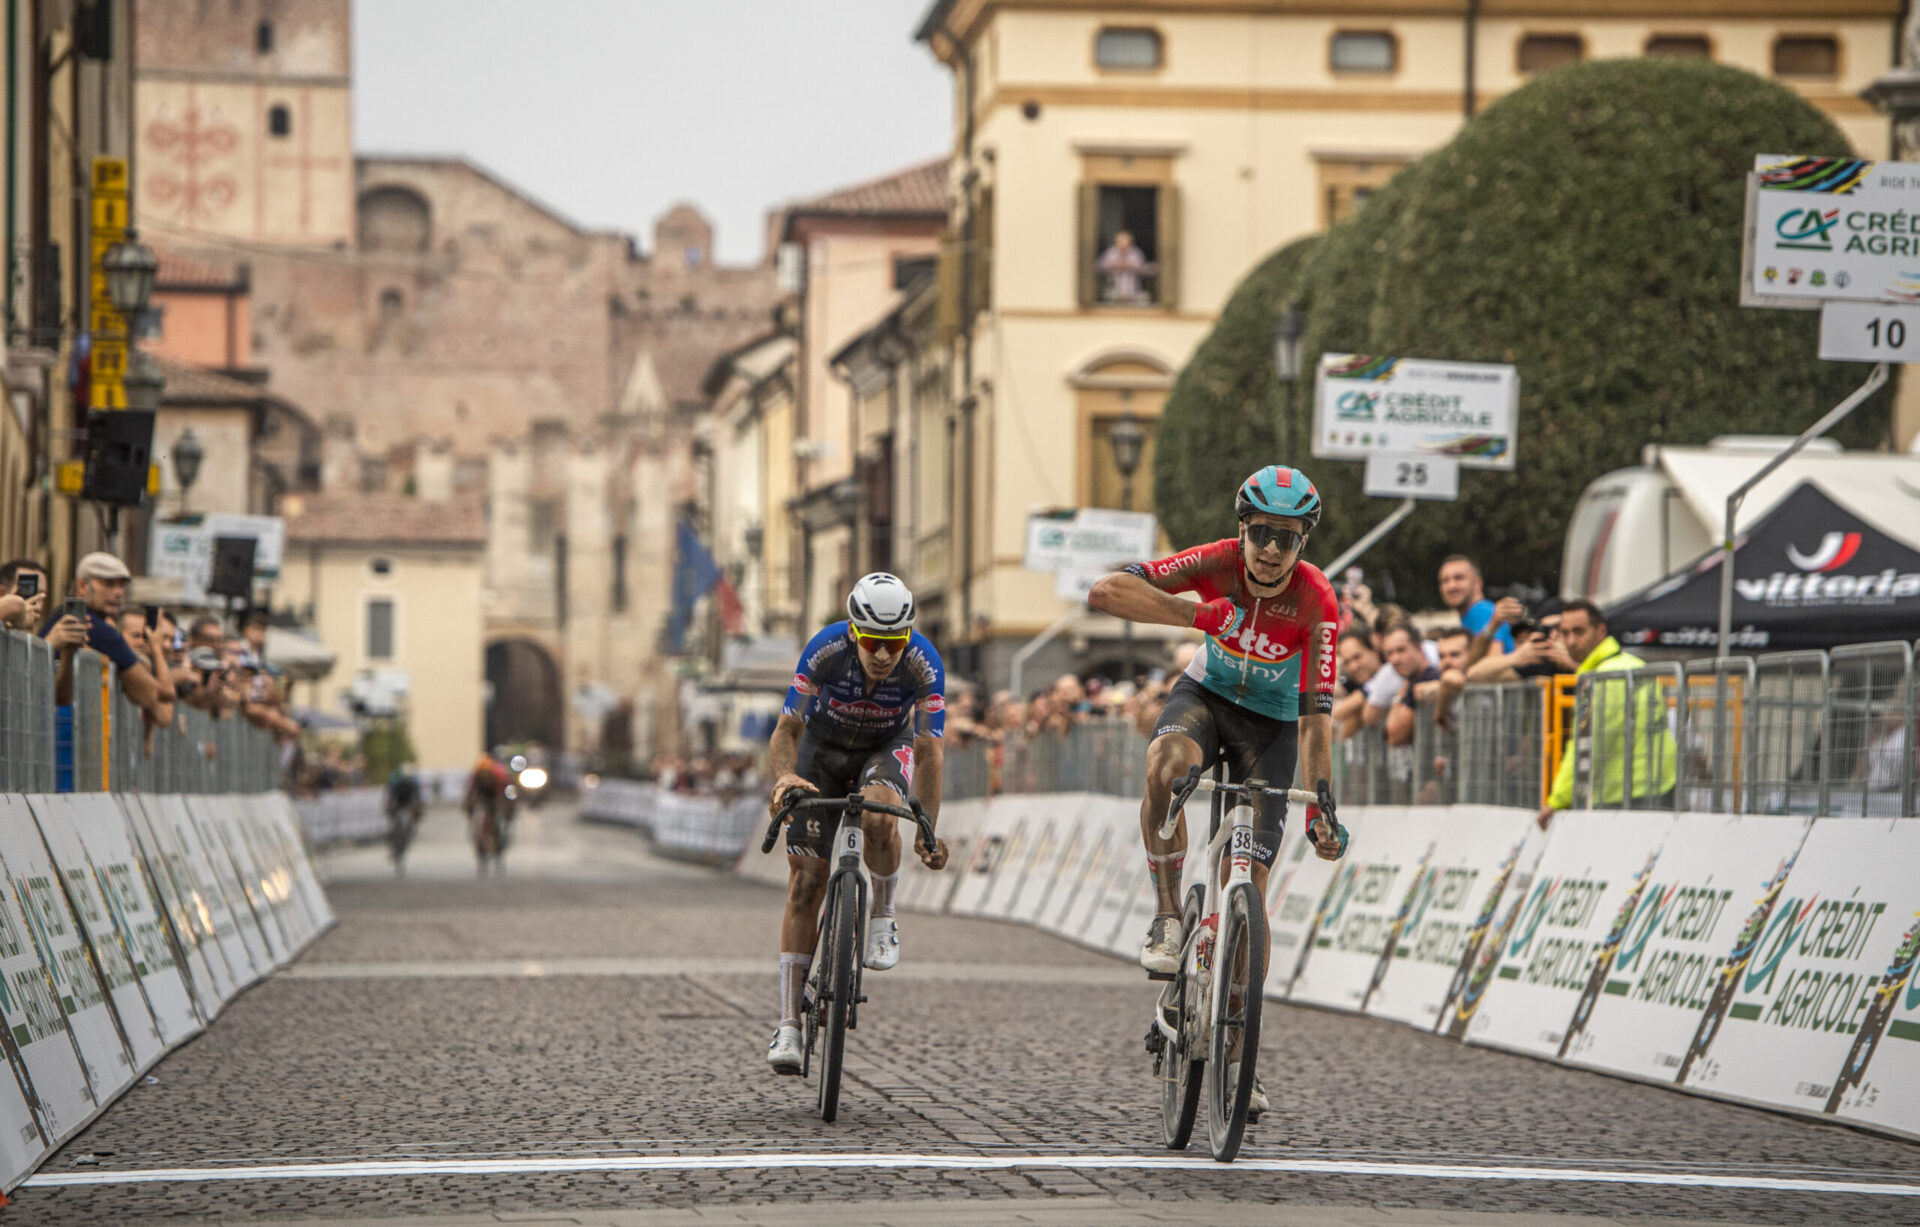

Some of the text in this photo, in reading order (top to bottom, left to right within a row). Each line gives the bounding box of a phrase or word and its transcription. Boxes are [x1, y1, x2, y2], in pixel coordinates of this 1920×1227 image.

[1866, 318, 1906, 349] 10
[1396, 462, 1429, 487] 25
[1211, 642, 1287, 682] dstny
[1315, 621, 1337, 678] lotto
[847, 832, 857, 849] 6
[1234, 831, 1251, 850] 38
[1662, 874, 1734, 943] CRÉDIT
[1799, 885, 1888, 961] CRÉDIT
[1632, 949, 1726, 1011] AGRICOLE
[1764, 968, 1880, 1035] AGRICOLE
